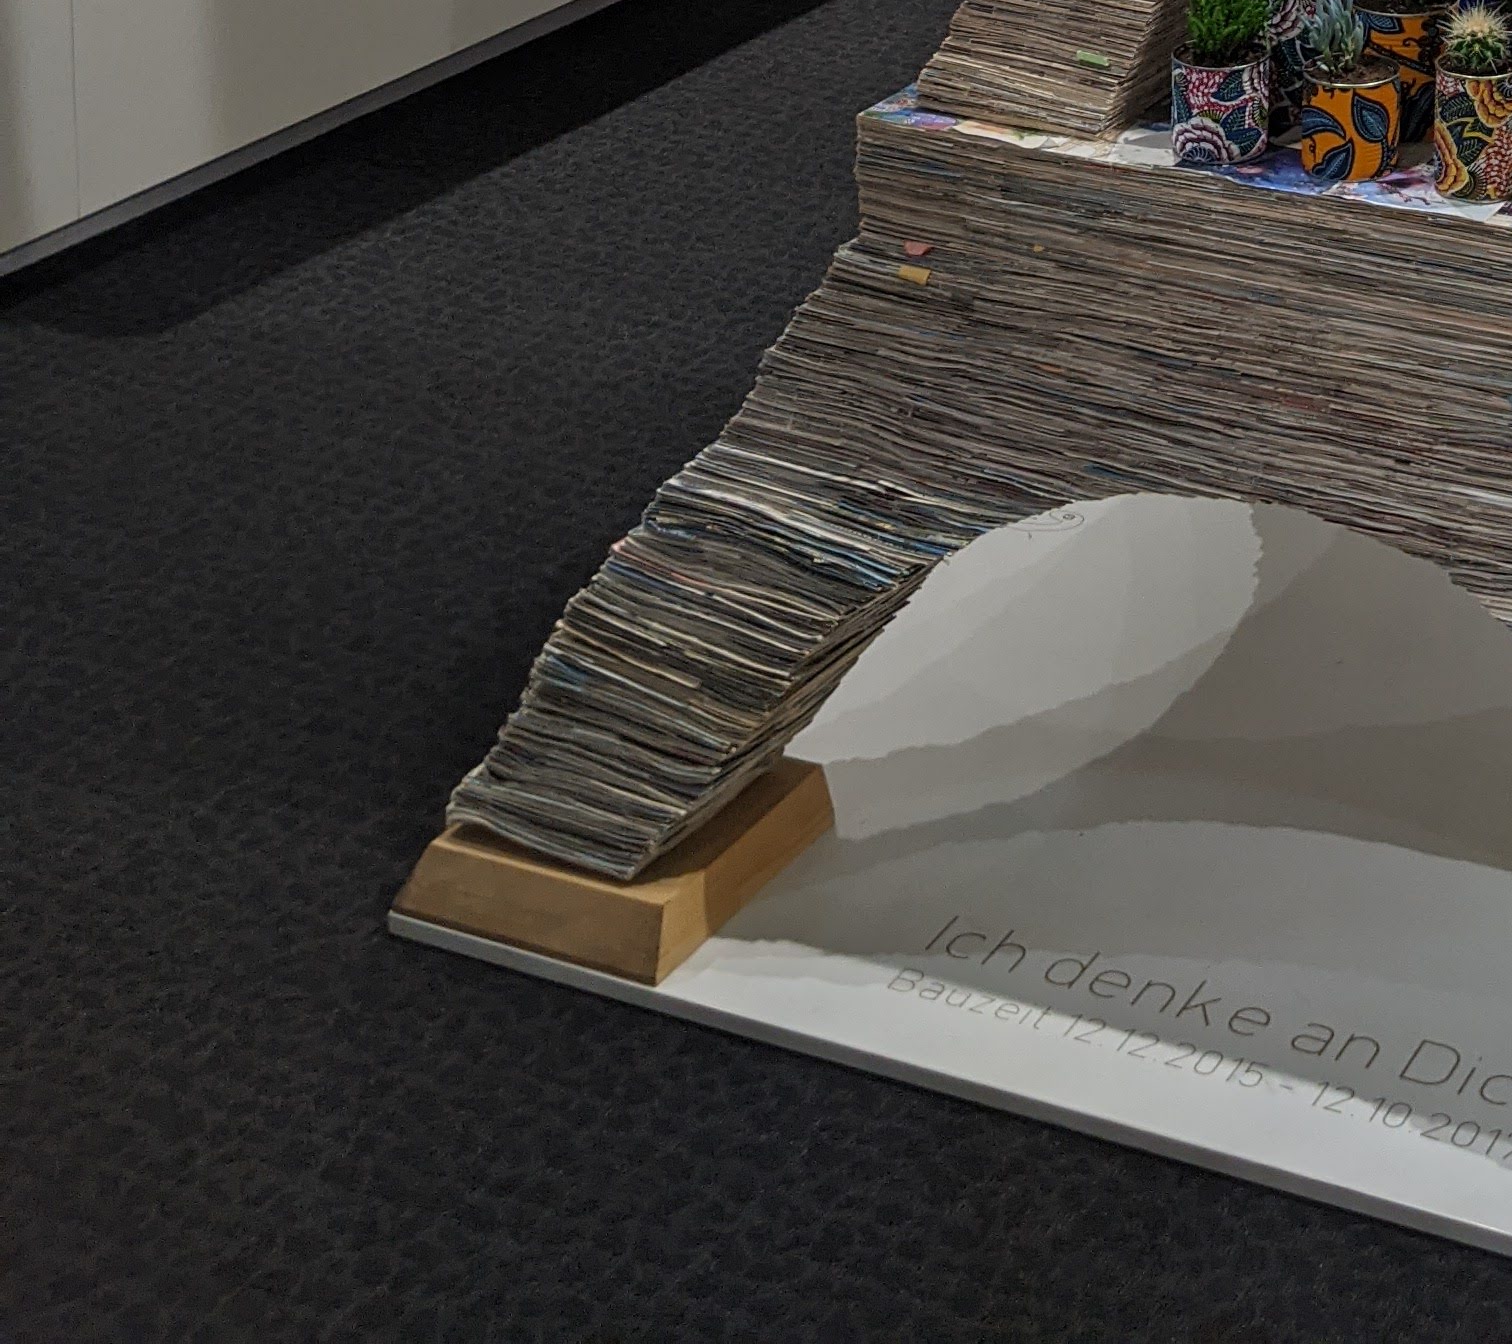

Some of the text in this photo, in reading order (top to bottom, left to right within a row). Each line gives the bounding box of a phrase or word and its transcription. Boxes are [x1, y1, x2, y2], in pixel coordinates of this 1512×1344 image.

[886, 966, 1054, 1032] Bauzeit
[925, 915, 1032, 975] Ich
[1043, 949, 1273, 1038] denke
[1289, 1020, 1382, 1071] an
